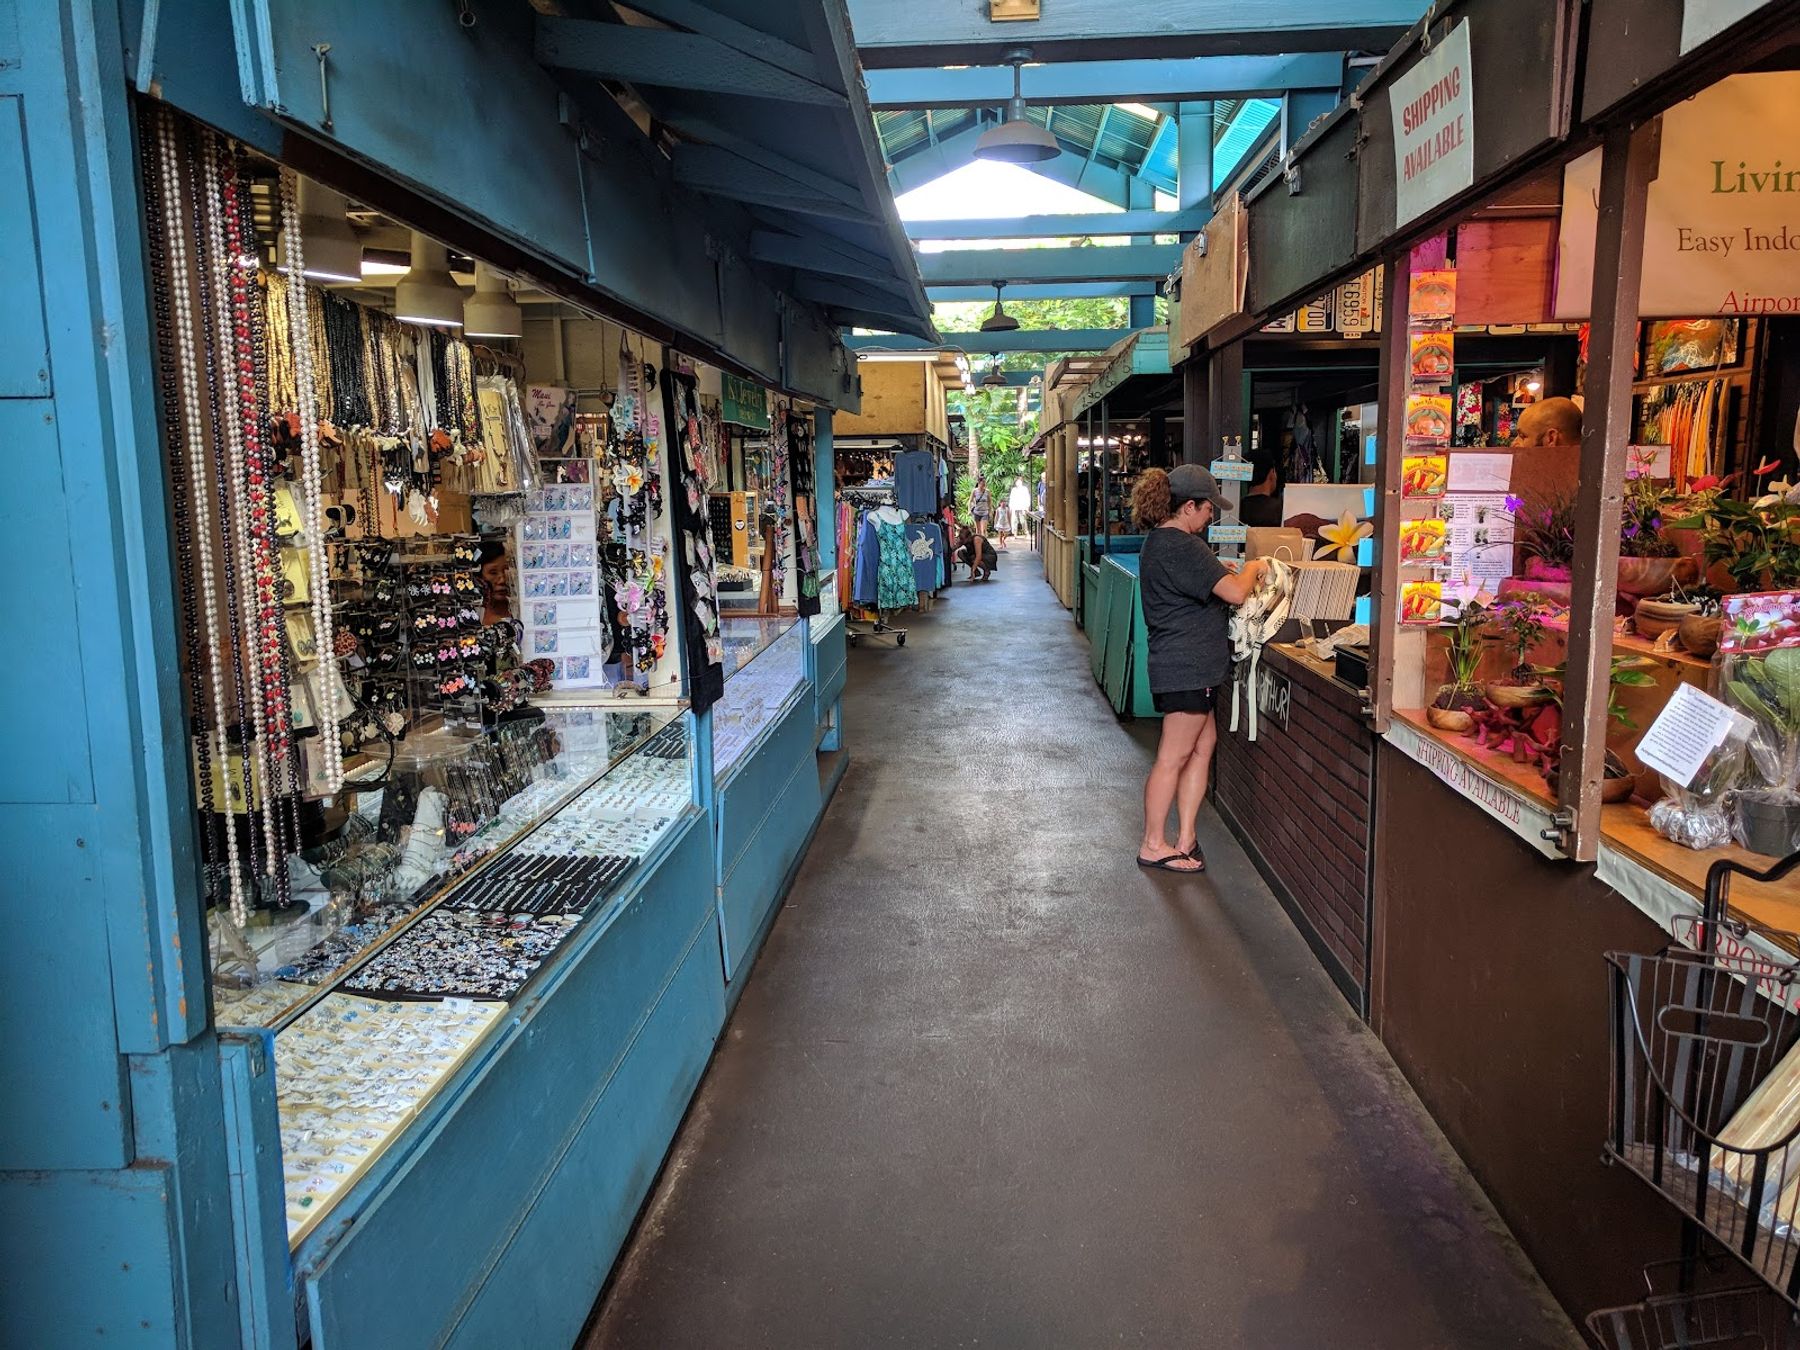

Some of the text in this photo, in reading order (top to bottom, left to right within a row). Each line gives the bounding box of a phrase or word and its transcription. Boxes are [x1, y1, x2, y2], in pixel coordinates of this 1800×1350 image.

[1403, 66, 1460, 136] SHIPPING
[1404, 114, 1464, 183] AVAILABLE
[1677, 227, 1735, 258] Easy
[1343, 277, 1361, 327] E6959
[1416, 739, 1521, 825] SHIPPING AVAILABLE
[1684, 919, 1789, 1000] ARPORT
